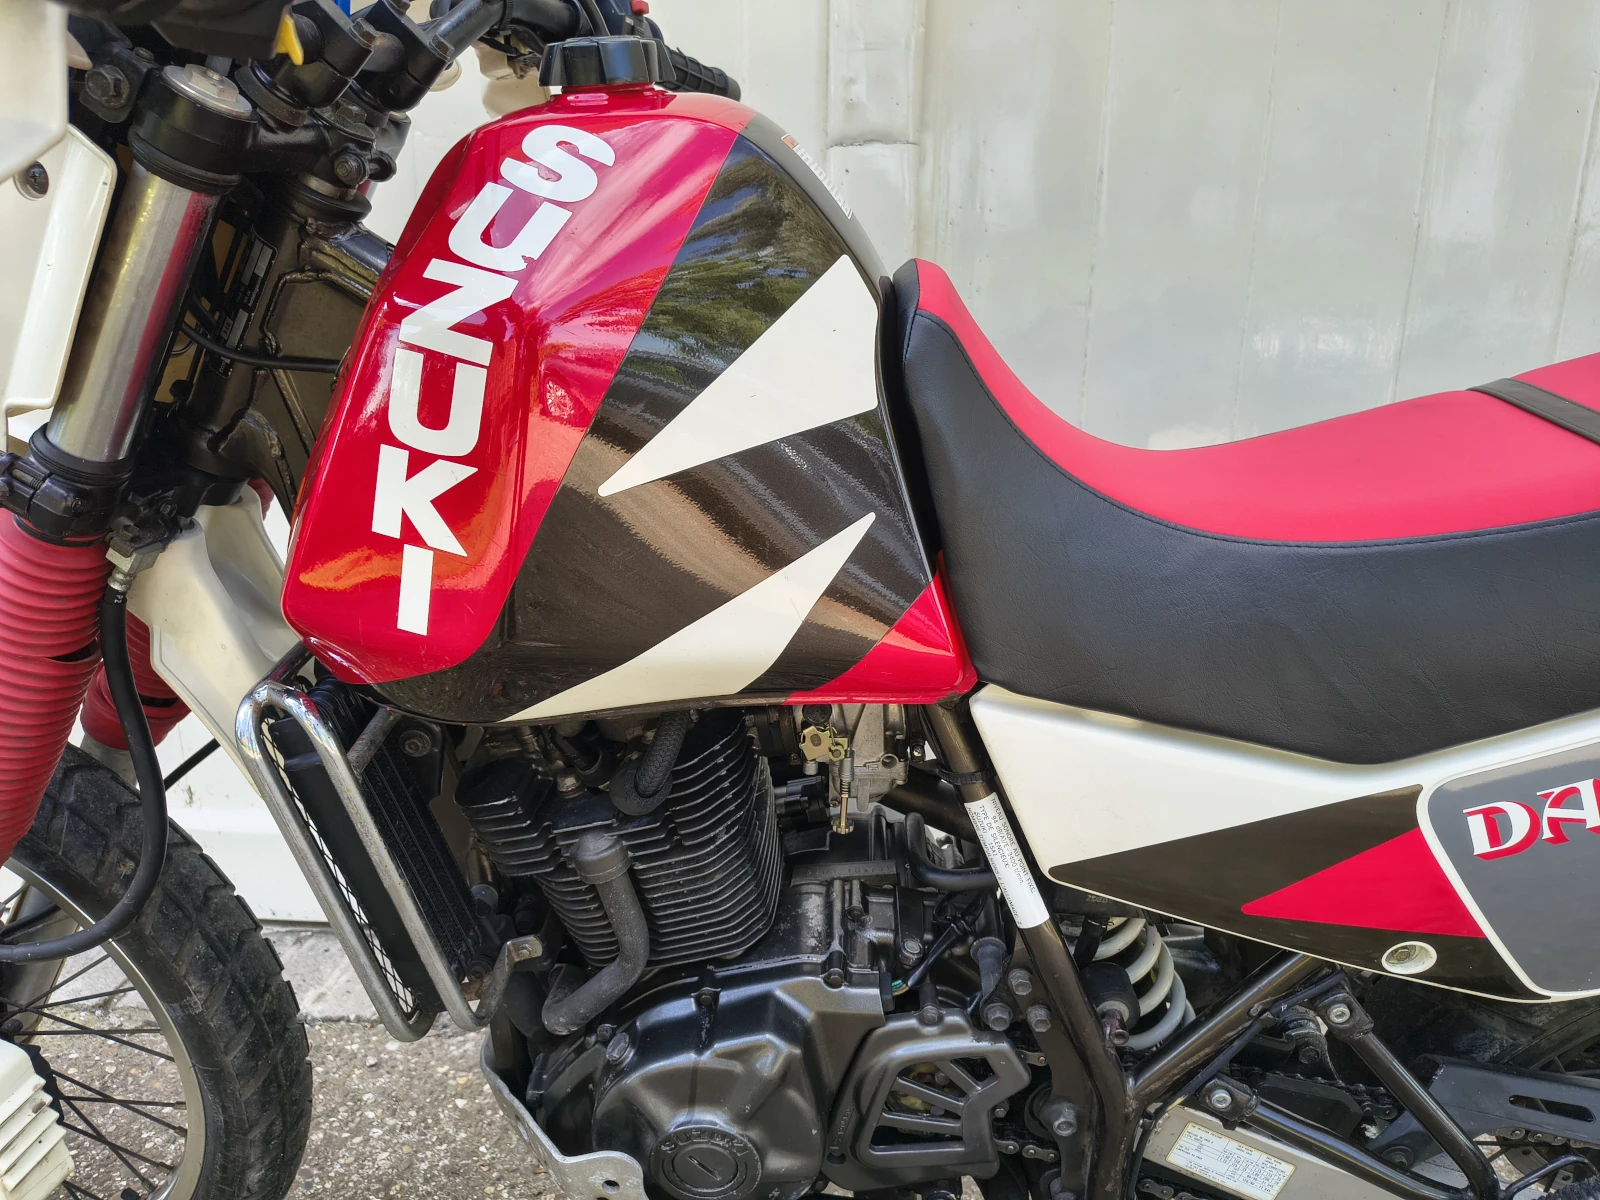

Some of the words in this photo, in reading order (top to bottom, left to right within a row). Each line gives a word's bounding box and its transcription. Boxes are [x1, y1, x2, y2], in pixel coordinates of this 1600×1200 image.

[371, 124, 616, 636] SUZUKI
[974, 811, 987, 834] SUZUKI
[978, 804, 989, 820] TYPE
[990, 797, 1004, 820] NIVEAU
[1001, 822, 1015, 846] SONORE
[1016, 858, 1028, 876] POINT
